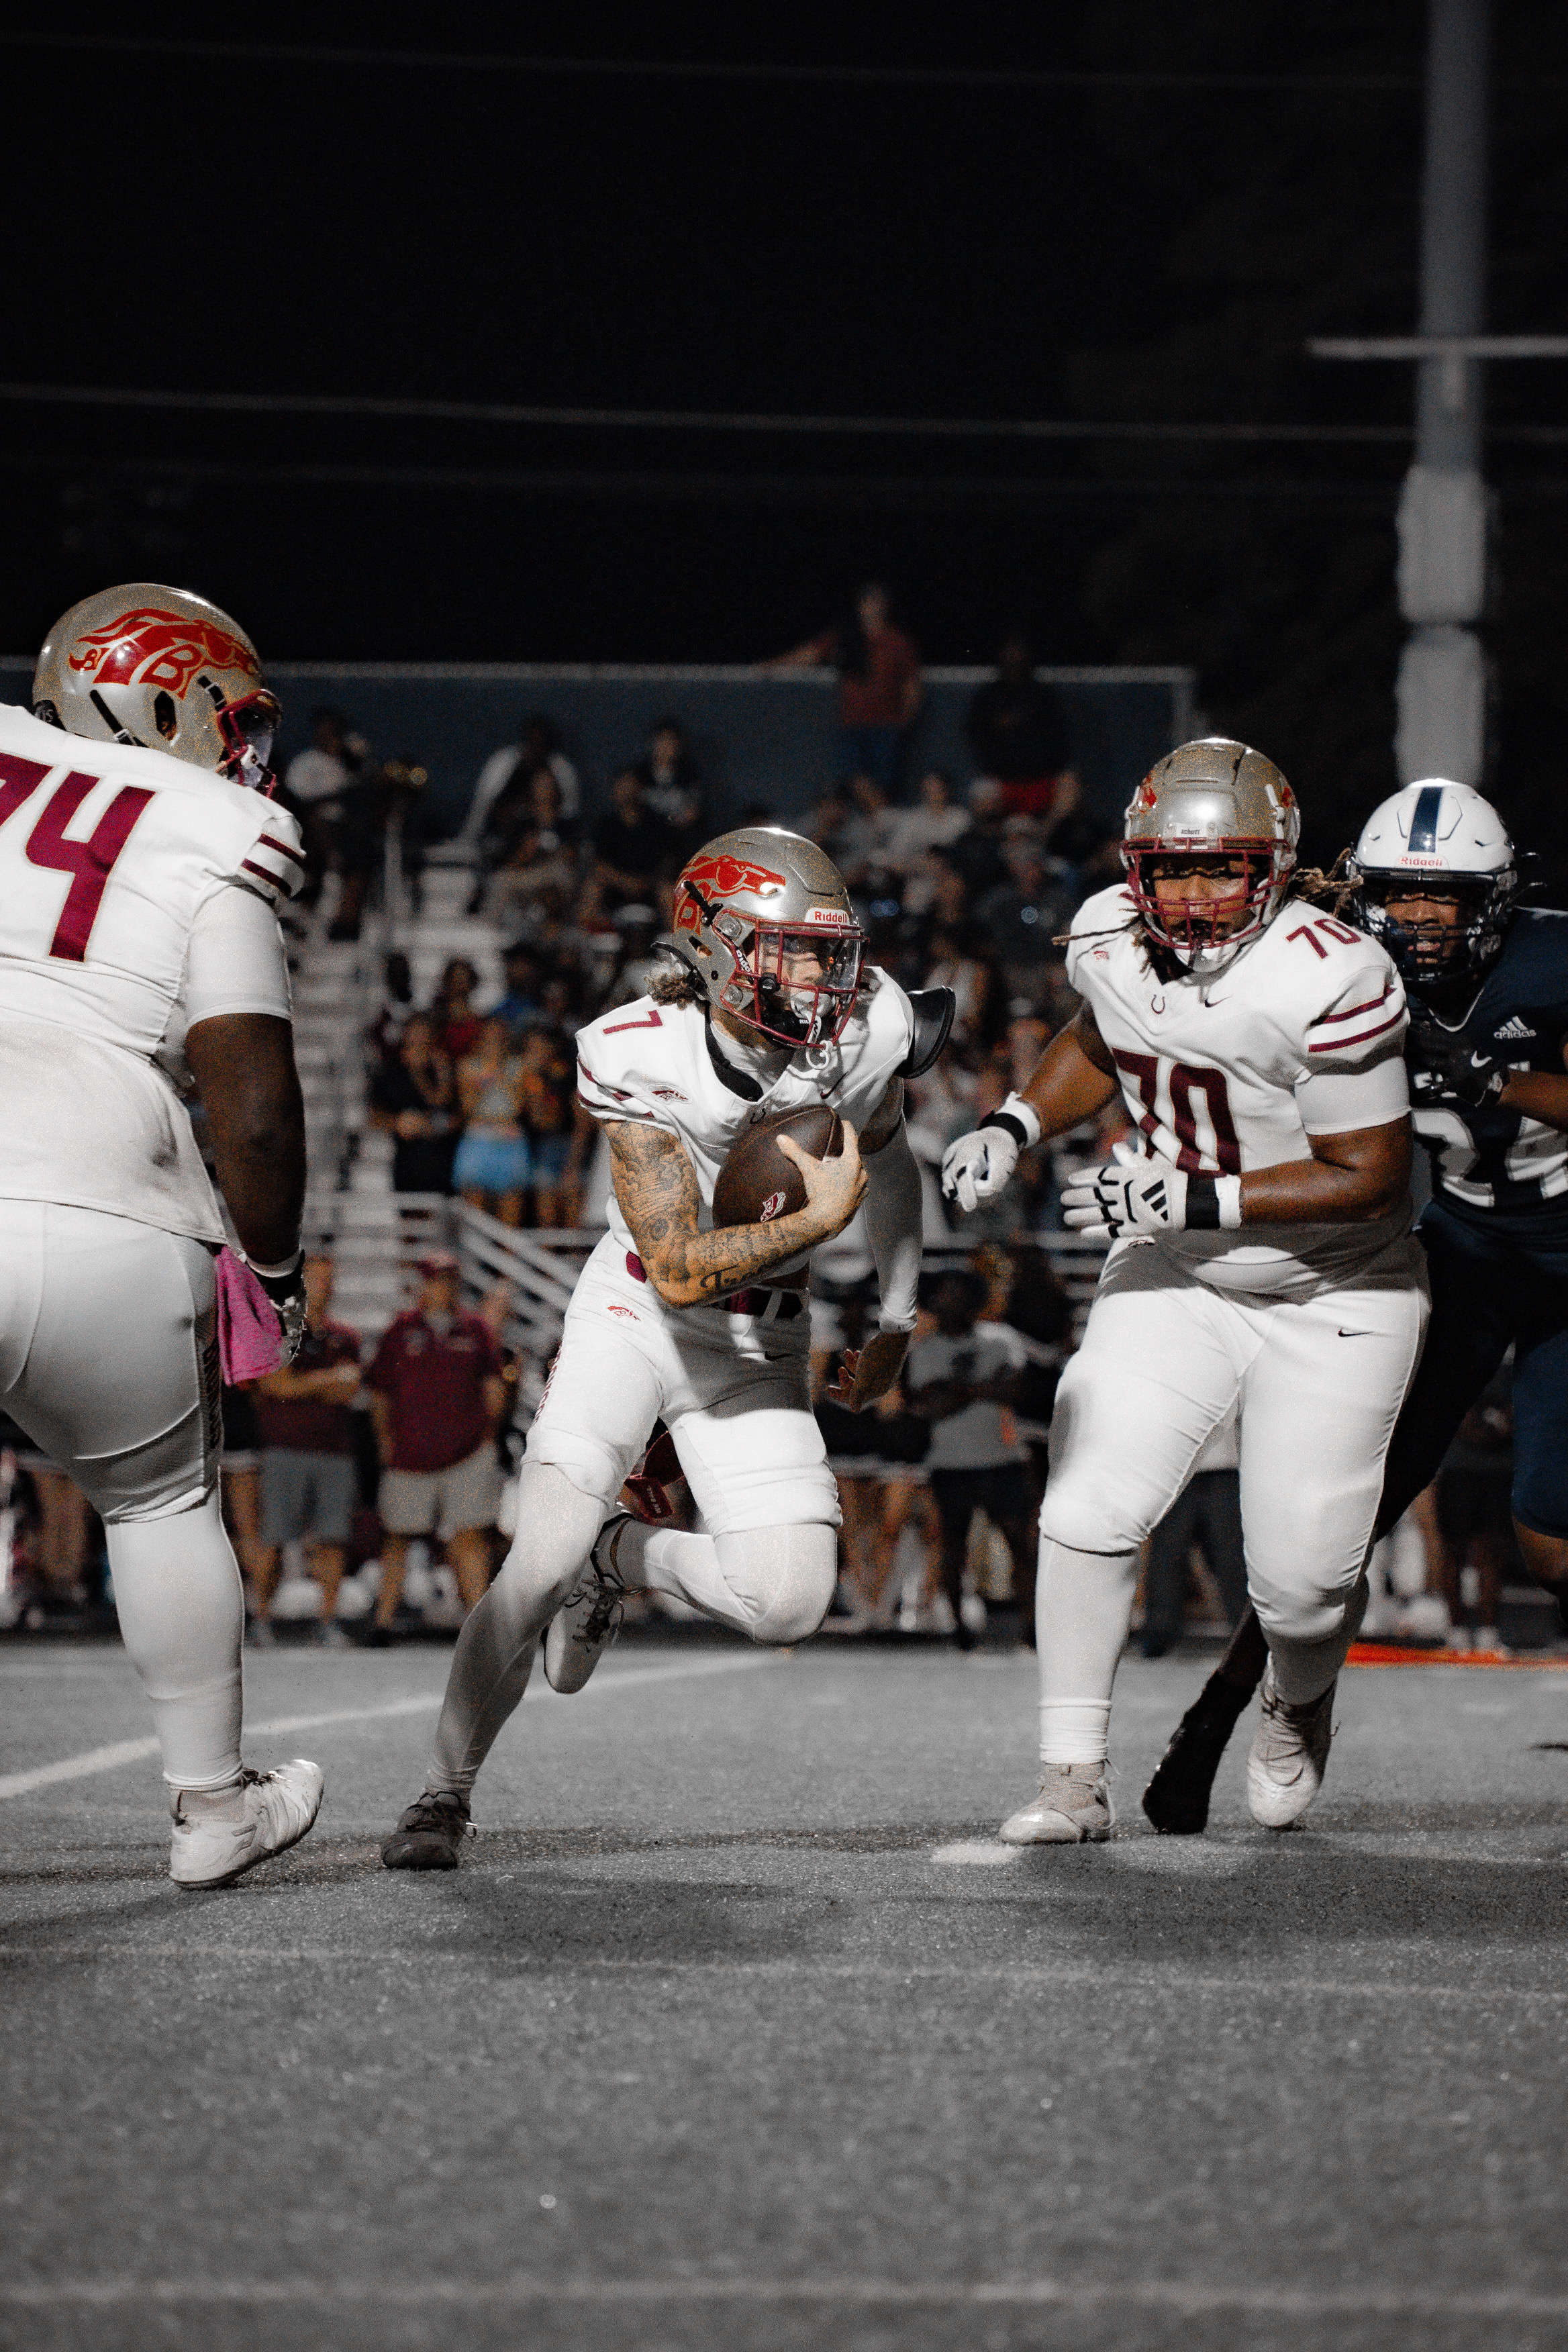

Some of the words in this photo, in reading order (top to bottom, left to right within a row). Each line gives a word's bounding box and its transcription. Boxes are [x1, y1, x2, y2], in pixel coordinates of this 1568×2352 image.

[1400, 856, 1443, 867] Riddell
[814, 910, 848, 924] Riddell
[1285, 918, 1361, 960] 70
[602, 1009, 663, 1035] 7
[1493, 1029, 1537, 1040] adidas
[1111, 1046, 1242, 1178] 70
